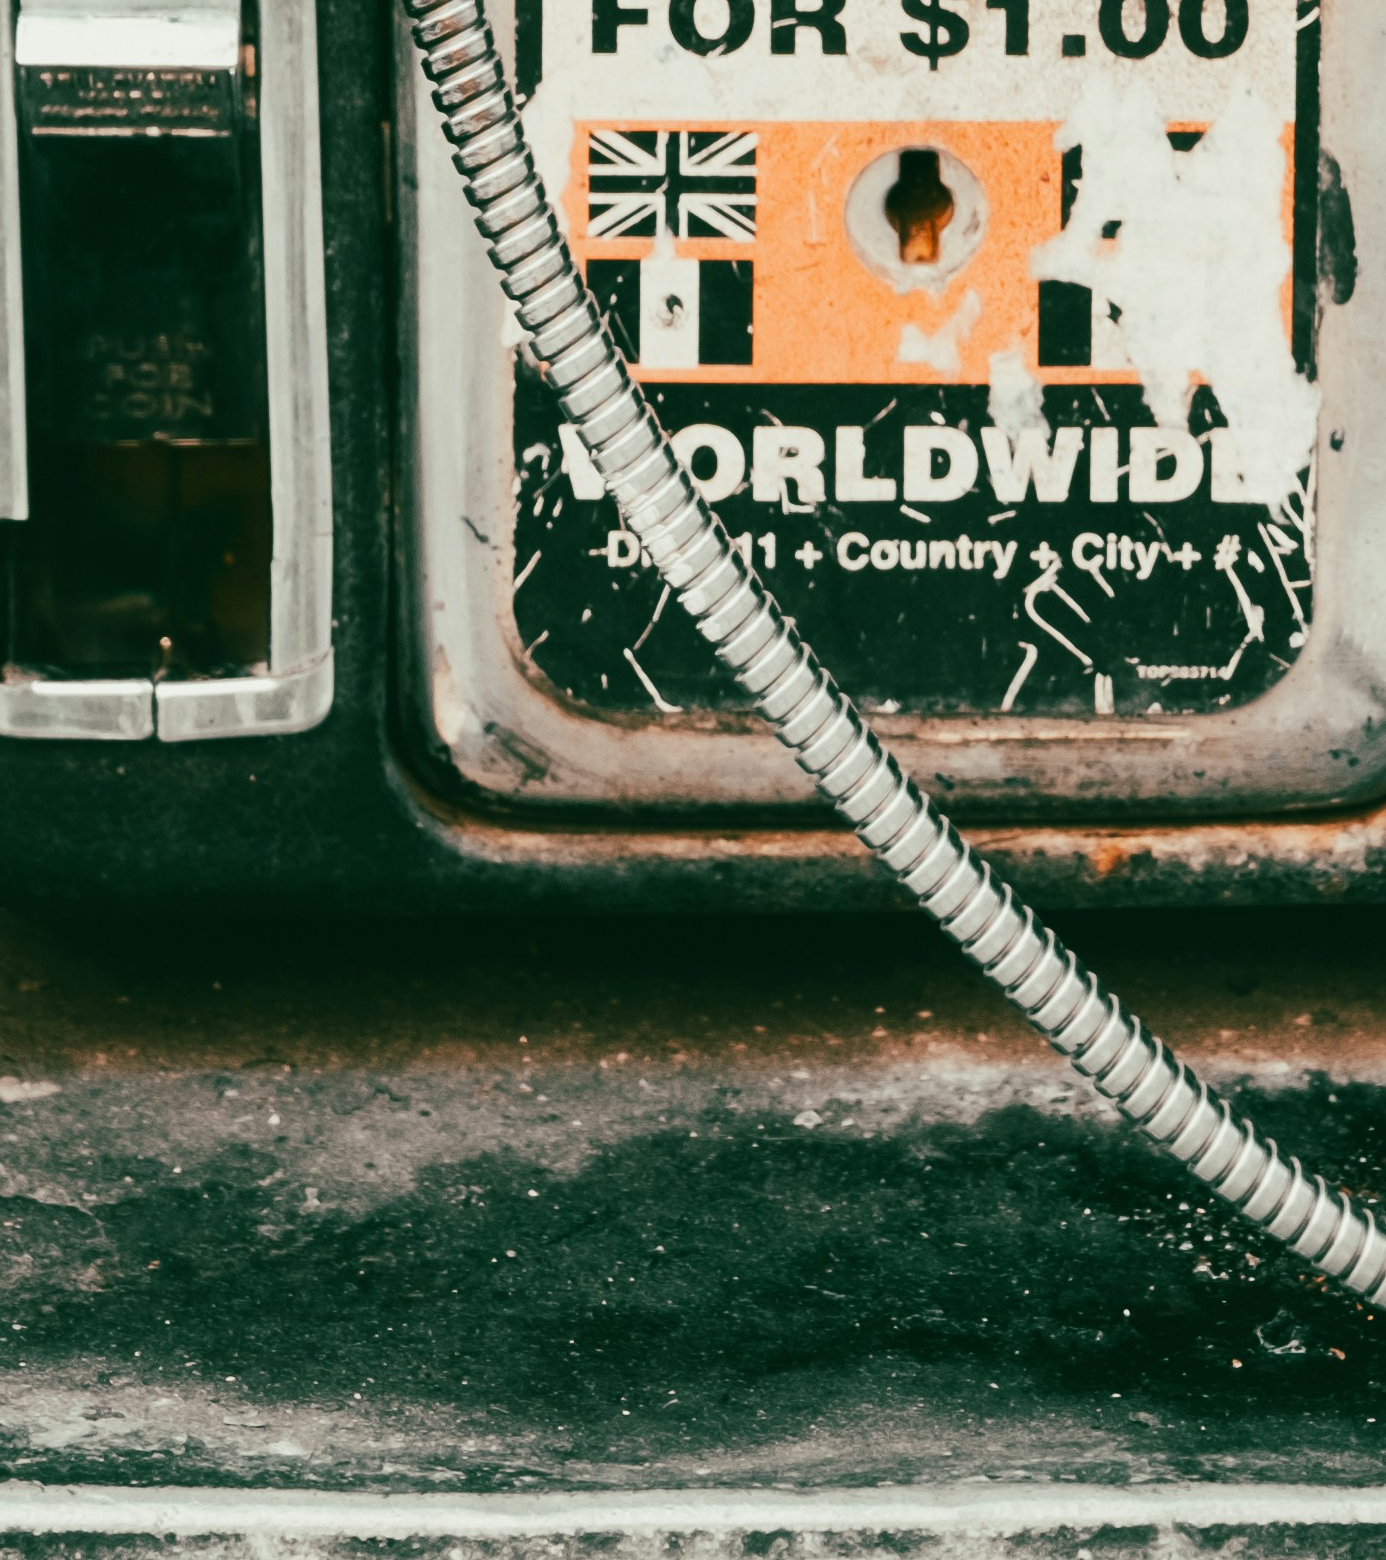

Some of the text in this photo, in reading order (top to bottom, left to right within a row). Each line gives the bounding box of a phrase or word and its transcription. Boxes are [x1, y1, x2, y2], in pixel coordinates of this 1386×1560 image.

[795, 531, 1241, 580] + Country + City + #
